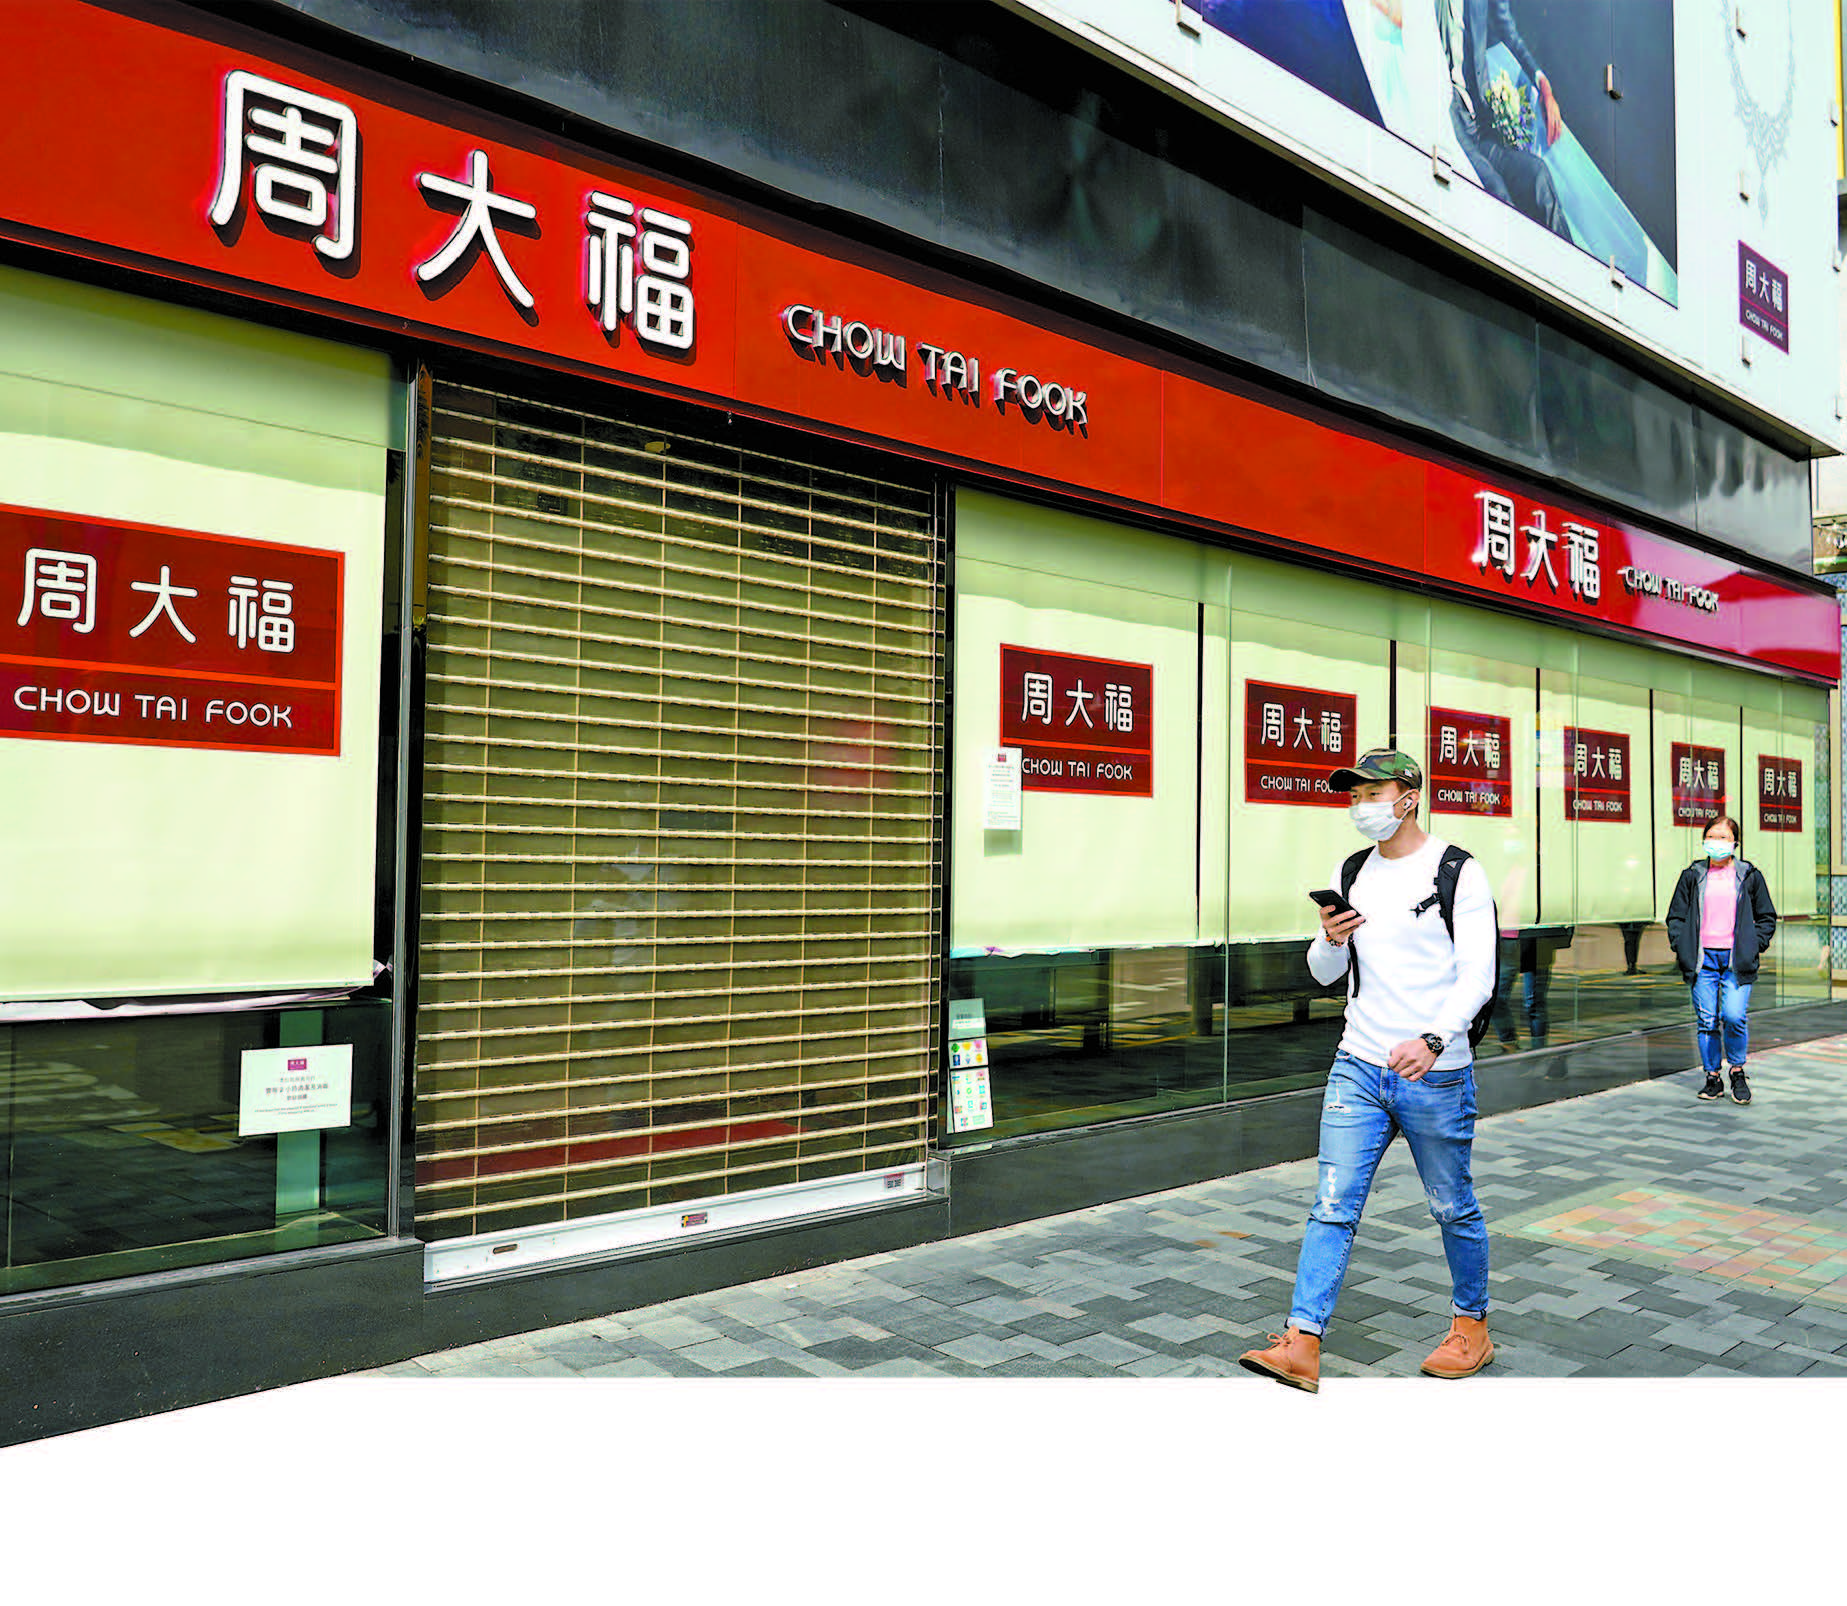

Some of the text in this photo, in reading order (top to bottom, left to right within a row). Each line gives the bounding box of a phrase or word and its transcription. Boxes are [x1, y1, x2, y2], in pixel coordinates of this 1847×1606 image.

[208, 69, 695, 350] 周大福
[1745, 259, 1783, 312] 周大福
[782, 303, 1088, 424] CHOW TAI FOOK
[1471, 490, 1600, 599] 周大福
[16, 547, 295, 653] 周大福
[1617, 566, 1719, 611] CHOW TAI FOOK
[13, 685, 293, 728] CHOW TAI FOOK
[1021, 671, 1133, 732] 周大福
[1261, 702, 1342, 753] 周大福
[1439, 725, 1500, 769] 周大福
[1021, 758, 1063, 776] CHOW
[1068, 761, 1090, 777] TAI
[1096, 763, 1133, 780] FOOK
[1260, 775, 1292, 791] CHOW
[1295, 777, 1311, 792] TAI
[1573, 743, 1622, 780] 周大福
[1679, 757, 1719, 790] 周大福
[1764, 767, 1797, 798] 周大福
[1438, 789, 1500, 805] CHOW TAI FOOK
[1572, 799, 1592, 811] CHOW
[1606, 801, 1623, 812] FOOK
